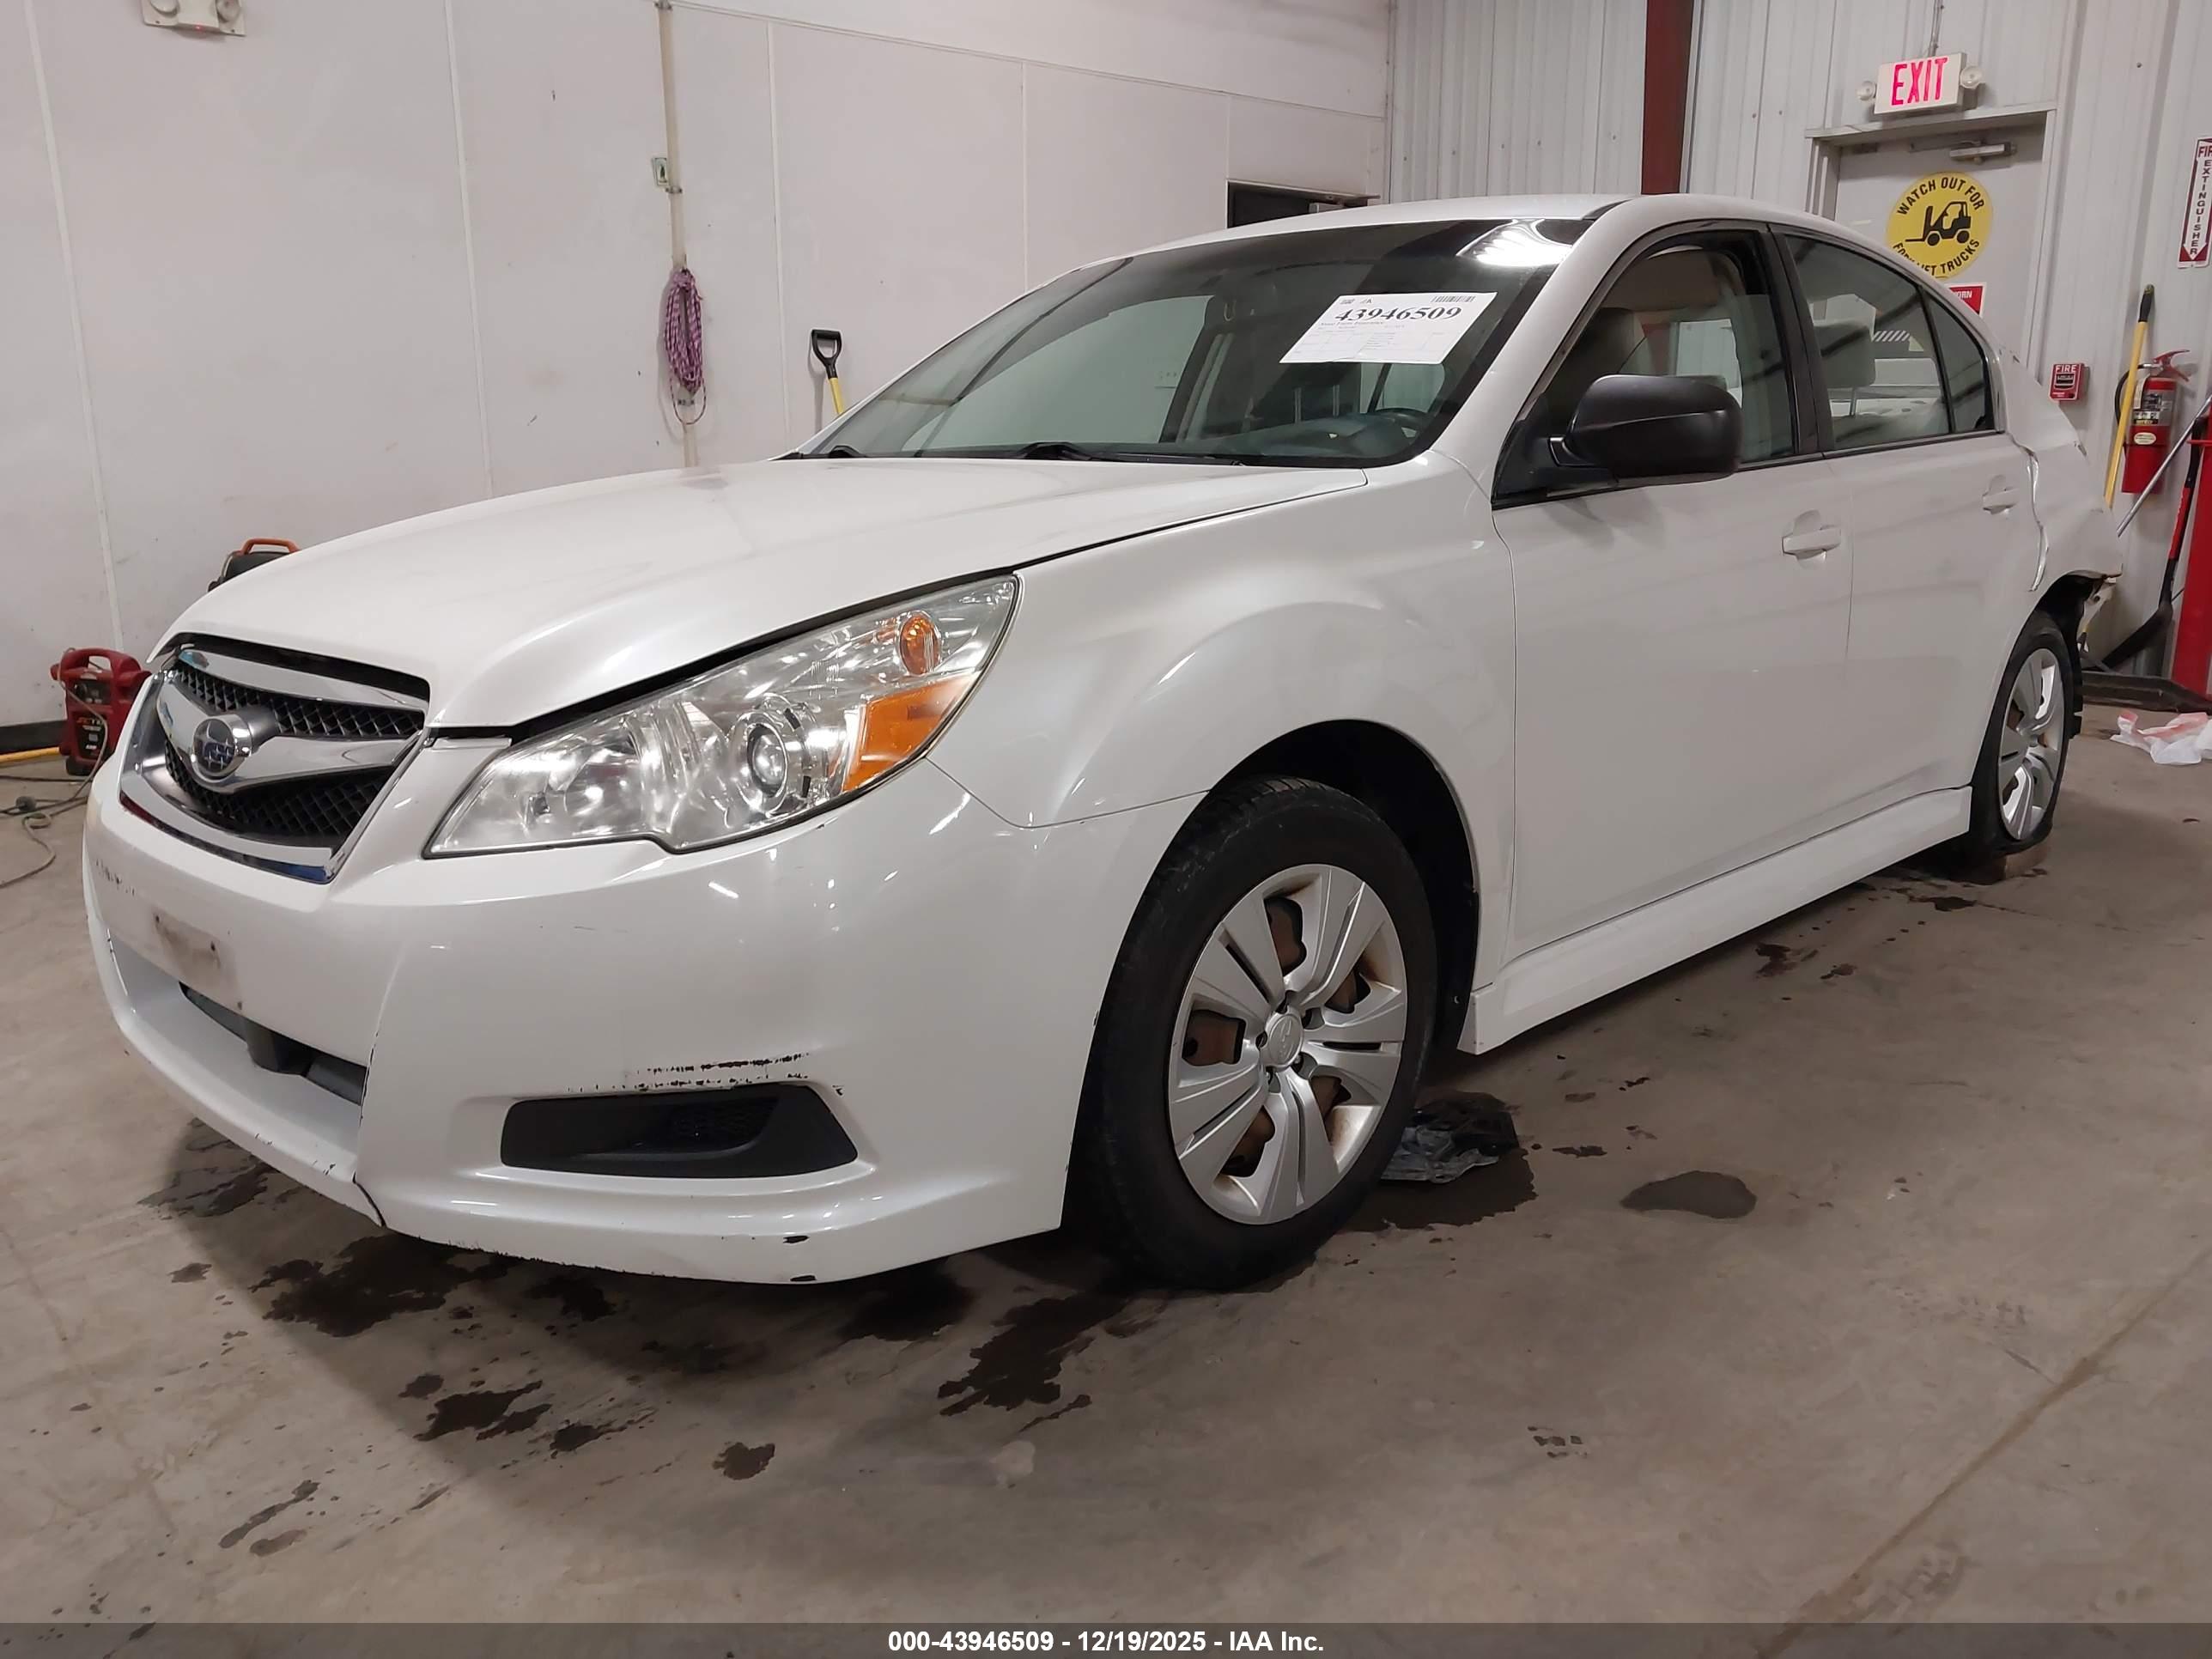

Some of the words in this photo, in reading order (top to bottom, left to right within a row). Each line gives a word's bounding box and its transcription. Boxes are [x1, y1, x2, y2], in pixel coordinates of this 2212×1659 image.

[1892, 58, 1948, 106] EXIT
[2198, 145, 2212, 158] FIR
[1897, 179, 1936, 216] WATCH
[1941, 177, 1966, 191] OUT
[1965, 185, 1984, 210] FOR
[2190, 160, 2212, 255] EXTINGUISHER
[1940, 239, 1980, 274] TRUCKS
[1335, 307, 1462, 321] 43946509
[2055, 364, 2077, 373] FIRE
